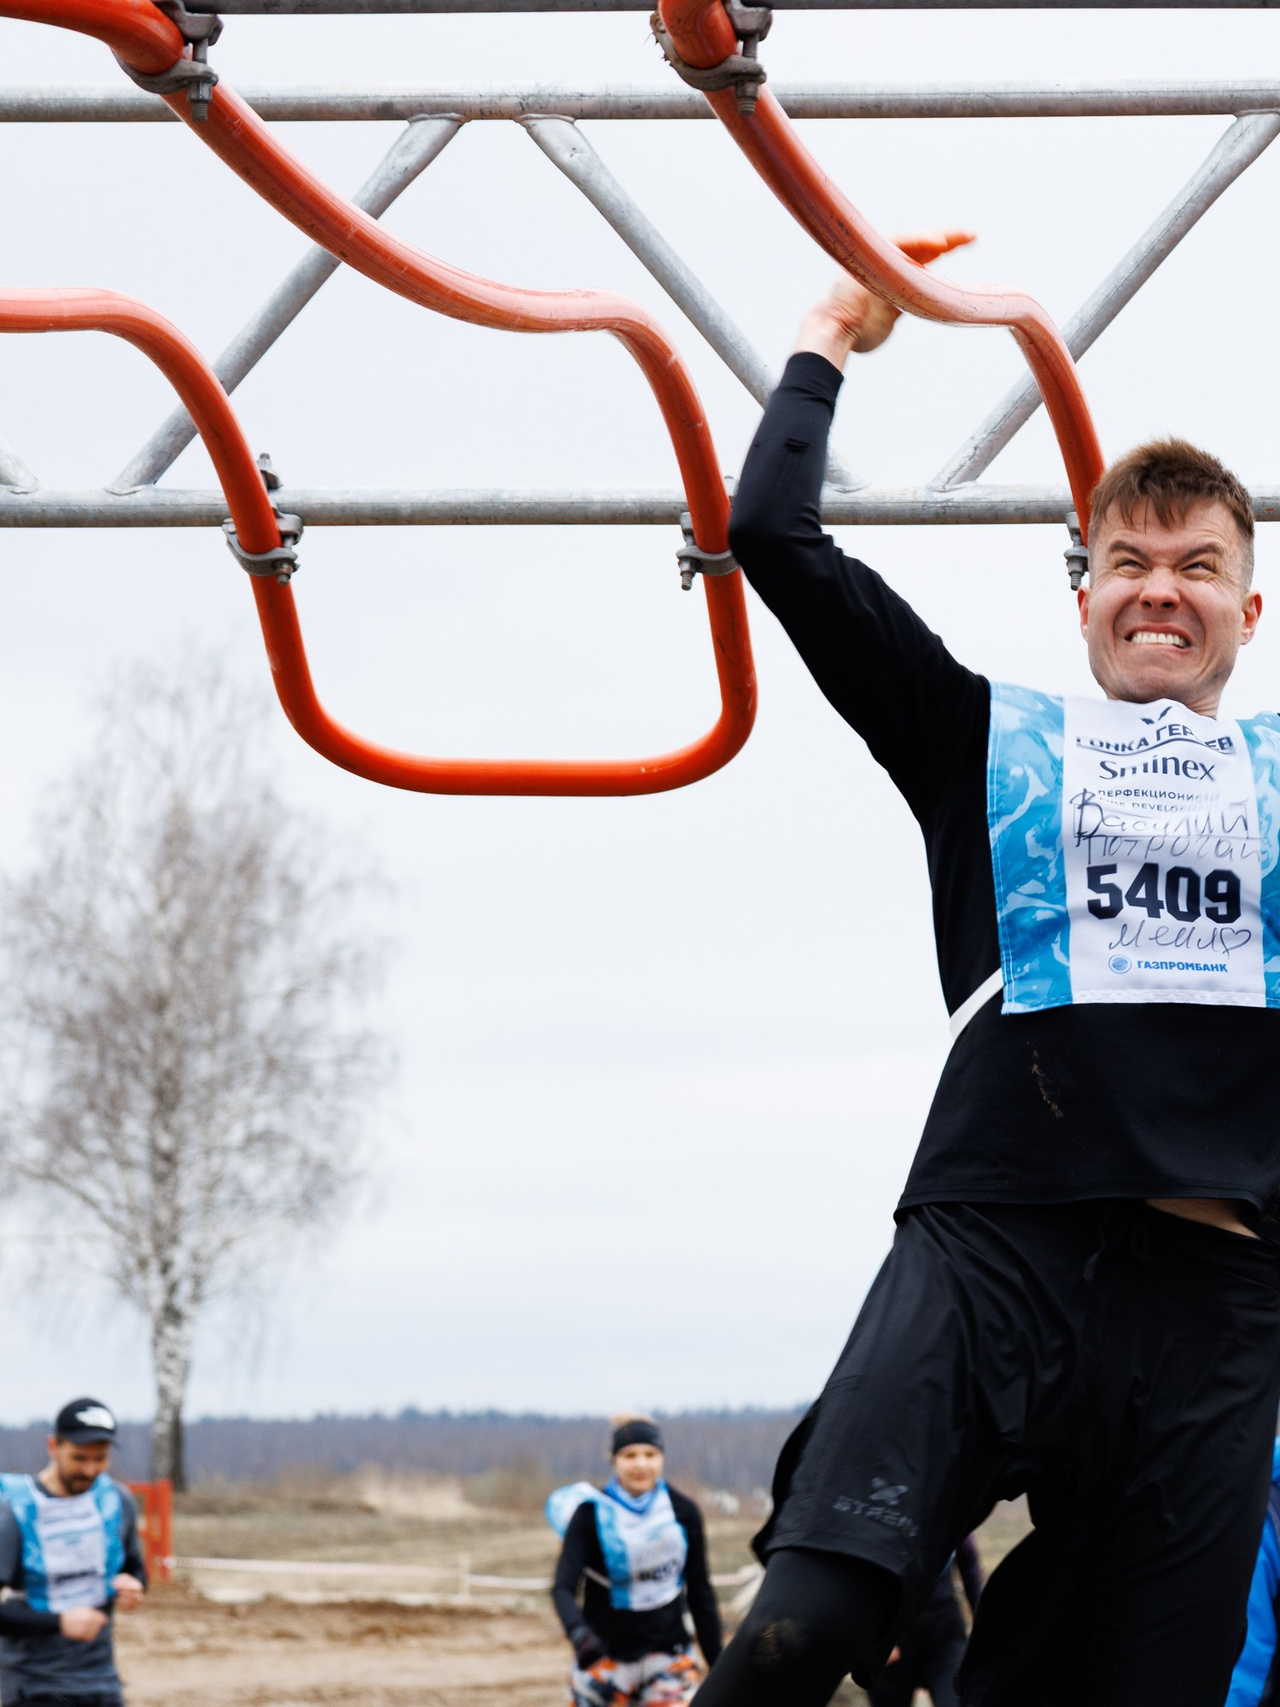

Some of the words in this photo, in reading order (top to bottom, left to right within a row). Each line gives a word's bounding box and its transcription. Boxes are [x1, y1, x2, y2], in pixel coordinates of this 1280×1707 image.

[1099, 755, 1216, 782] Sminex
[1086, 862, 1242, 924] 5409
[1137, 960, 1229, 973] ГАЗПРОМБАНК
